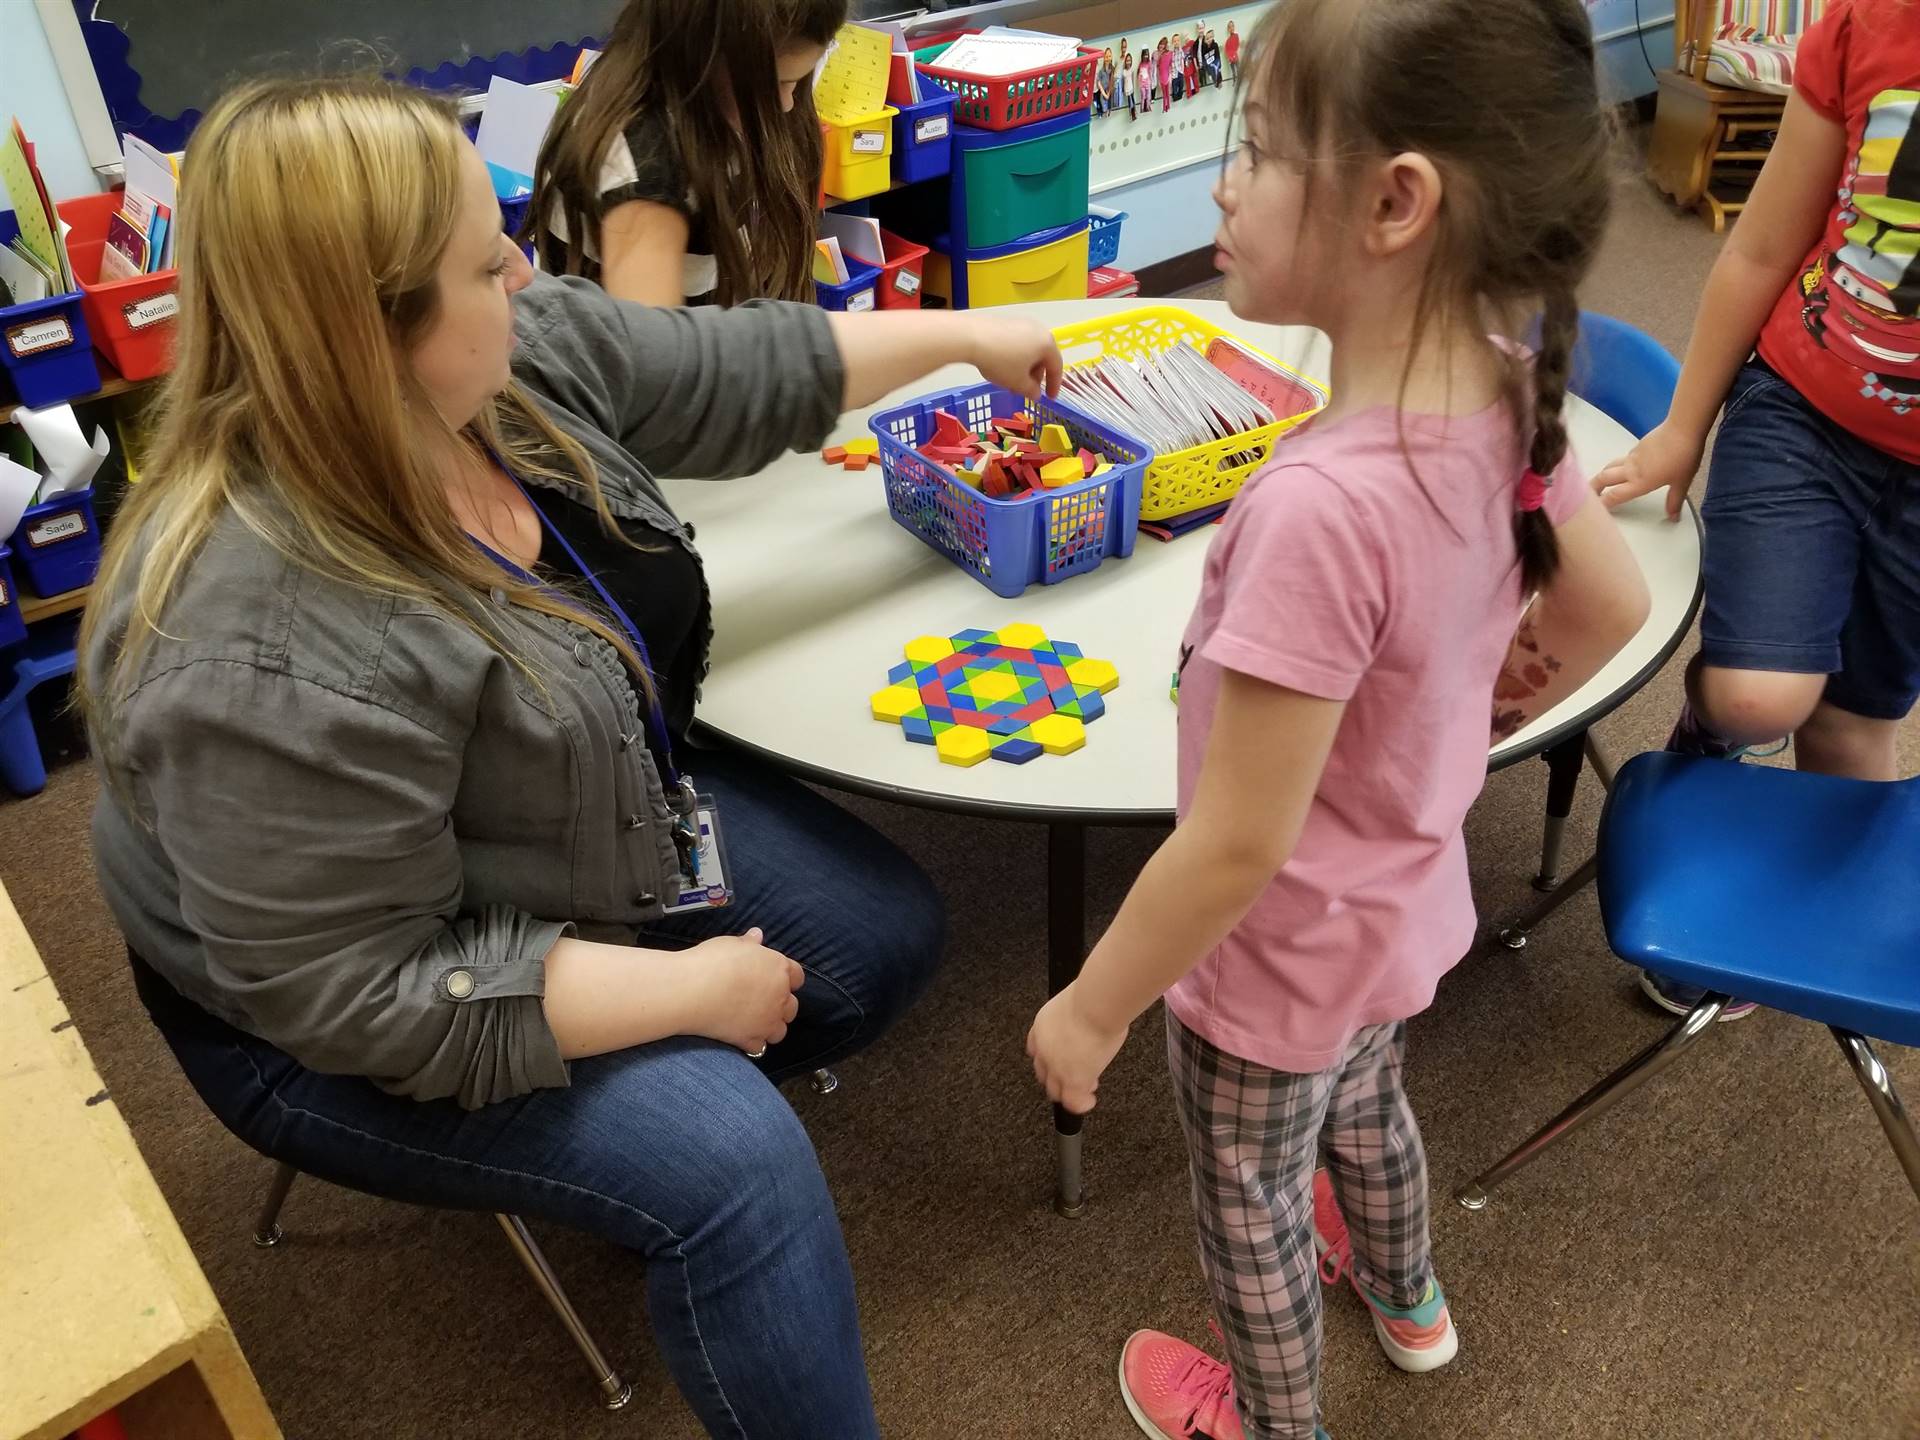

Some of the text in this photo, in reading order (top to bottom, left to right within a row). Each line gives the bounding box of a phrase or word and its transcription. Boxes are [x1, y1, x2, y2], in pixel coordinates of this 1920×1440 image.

[924, 125, 943, 135] Austin
[139, 302, 175, 320] Natalie
[22, 328, 65, 346] Camren
[45, 520, 75, 536] Sadie
